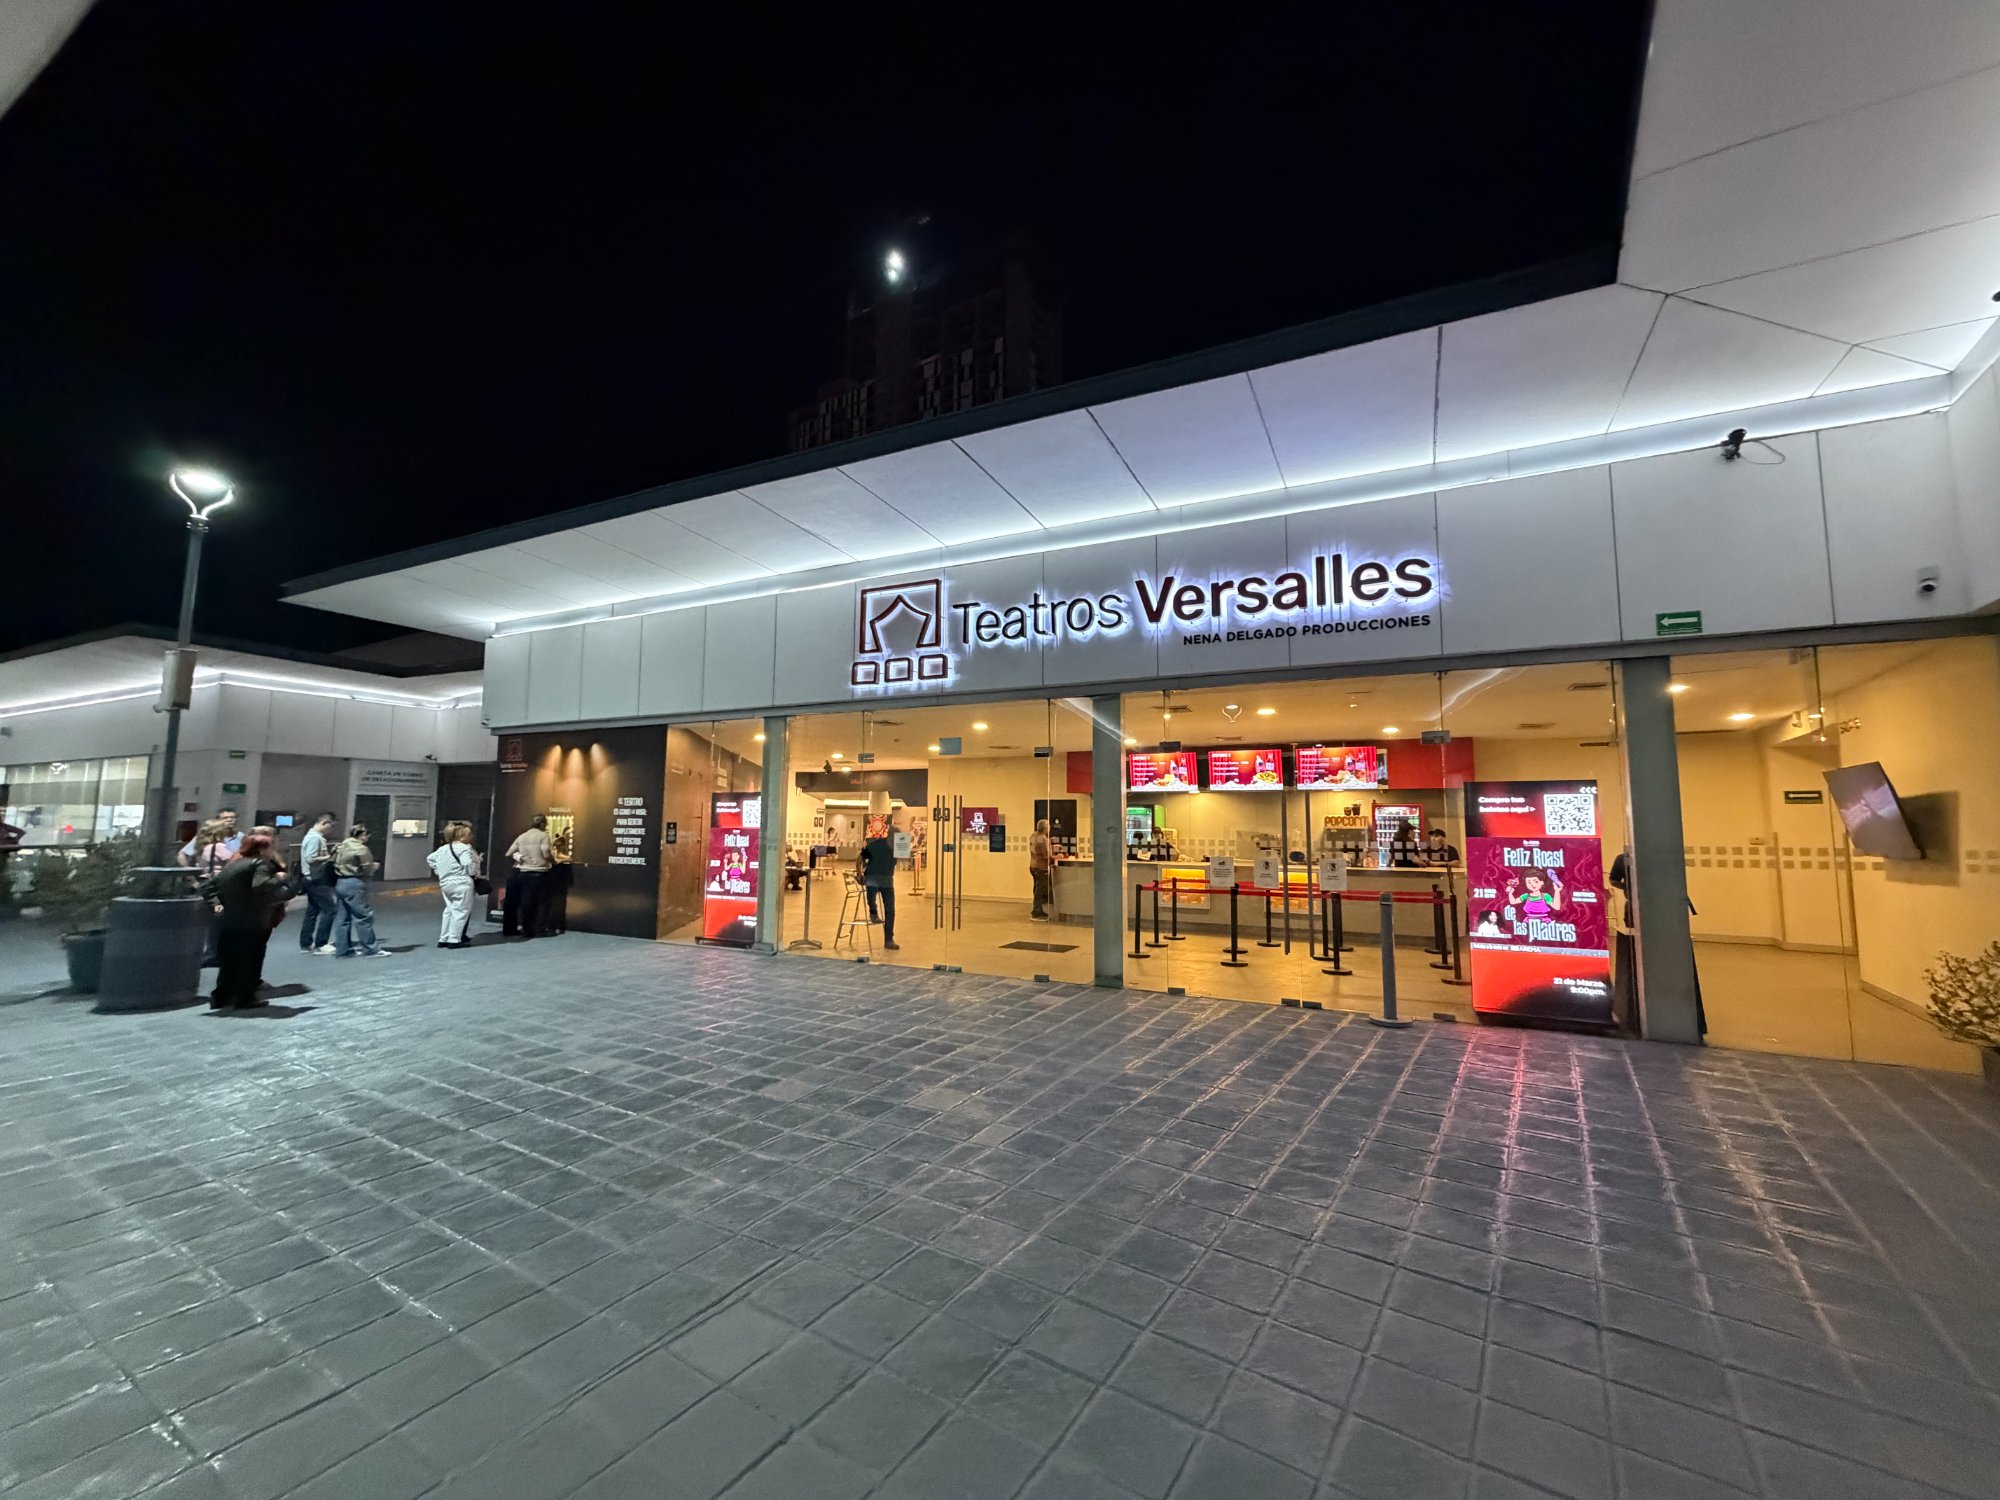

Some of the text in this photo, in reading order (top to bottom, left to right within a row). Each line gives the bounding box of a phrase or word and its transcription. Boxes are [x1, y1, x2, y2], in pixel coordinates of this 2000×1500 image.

[952, 553, 1434, 646] Teatros Versalles
[1183, 614, 1431, 645] NENA DELGADO PRODUCCIONES
[1503, 847, 1565, 869] Feliz Roast
[1473, 888, 1483, 899] 21
[1504, 905, 1517, 922] de
[1513, 918, 1577, 943] las Madres
